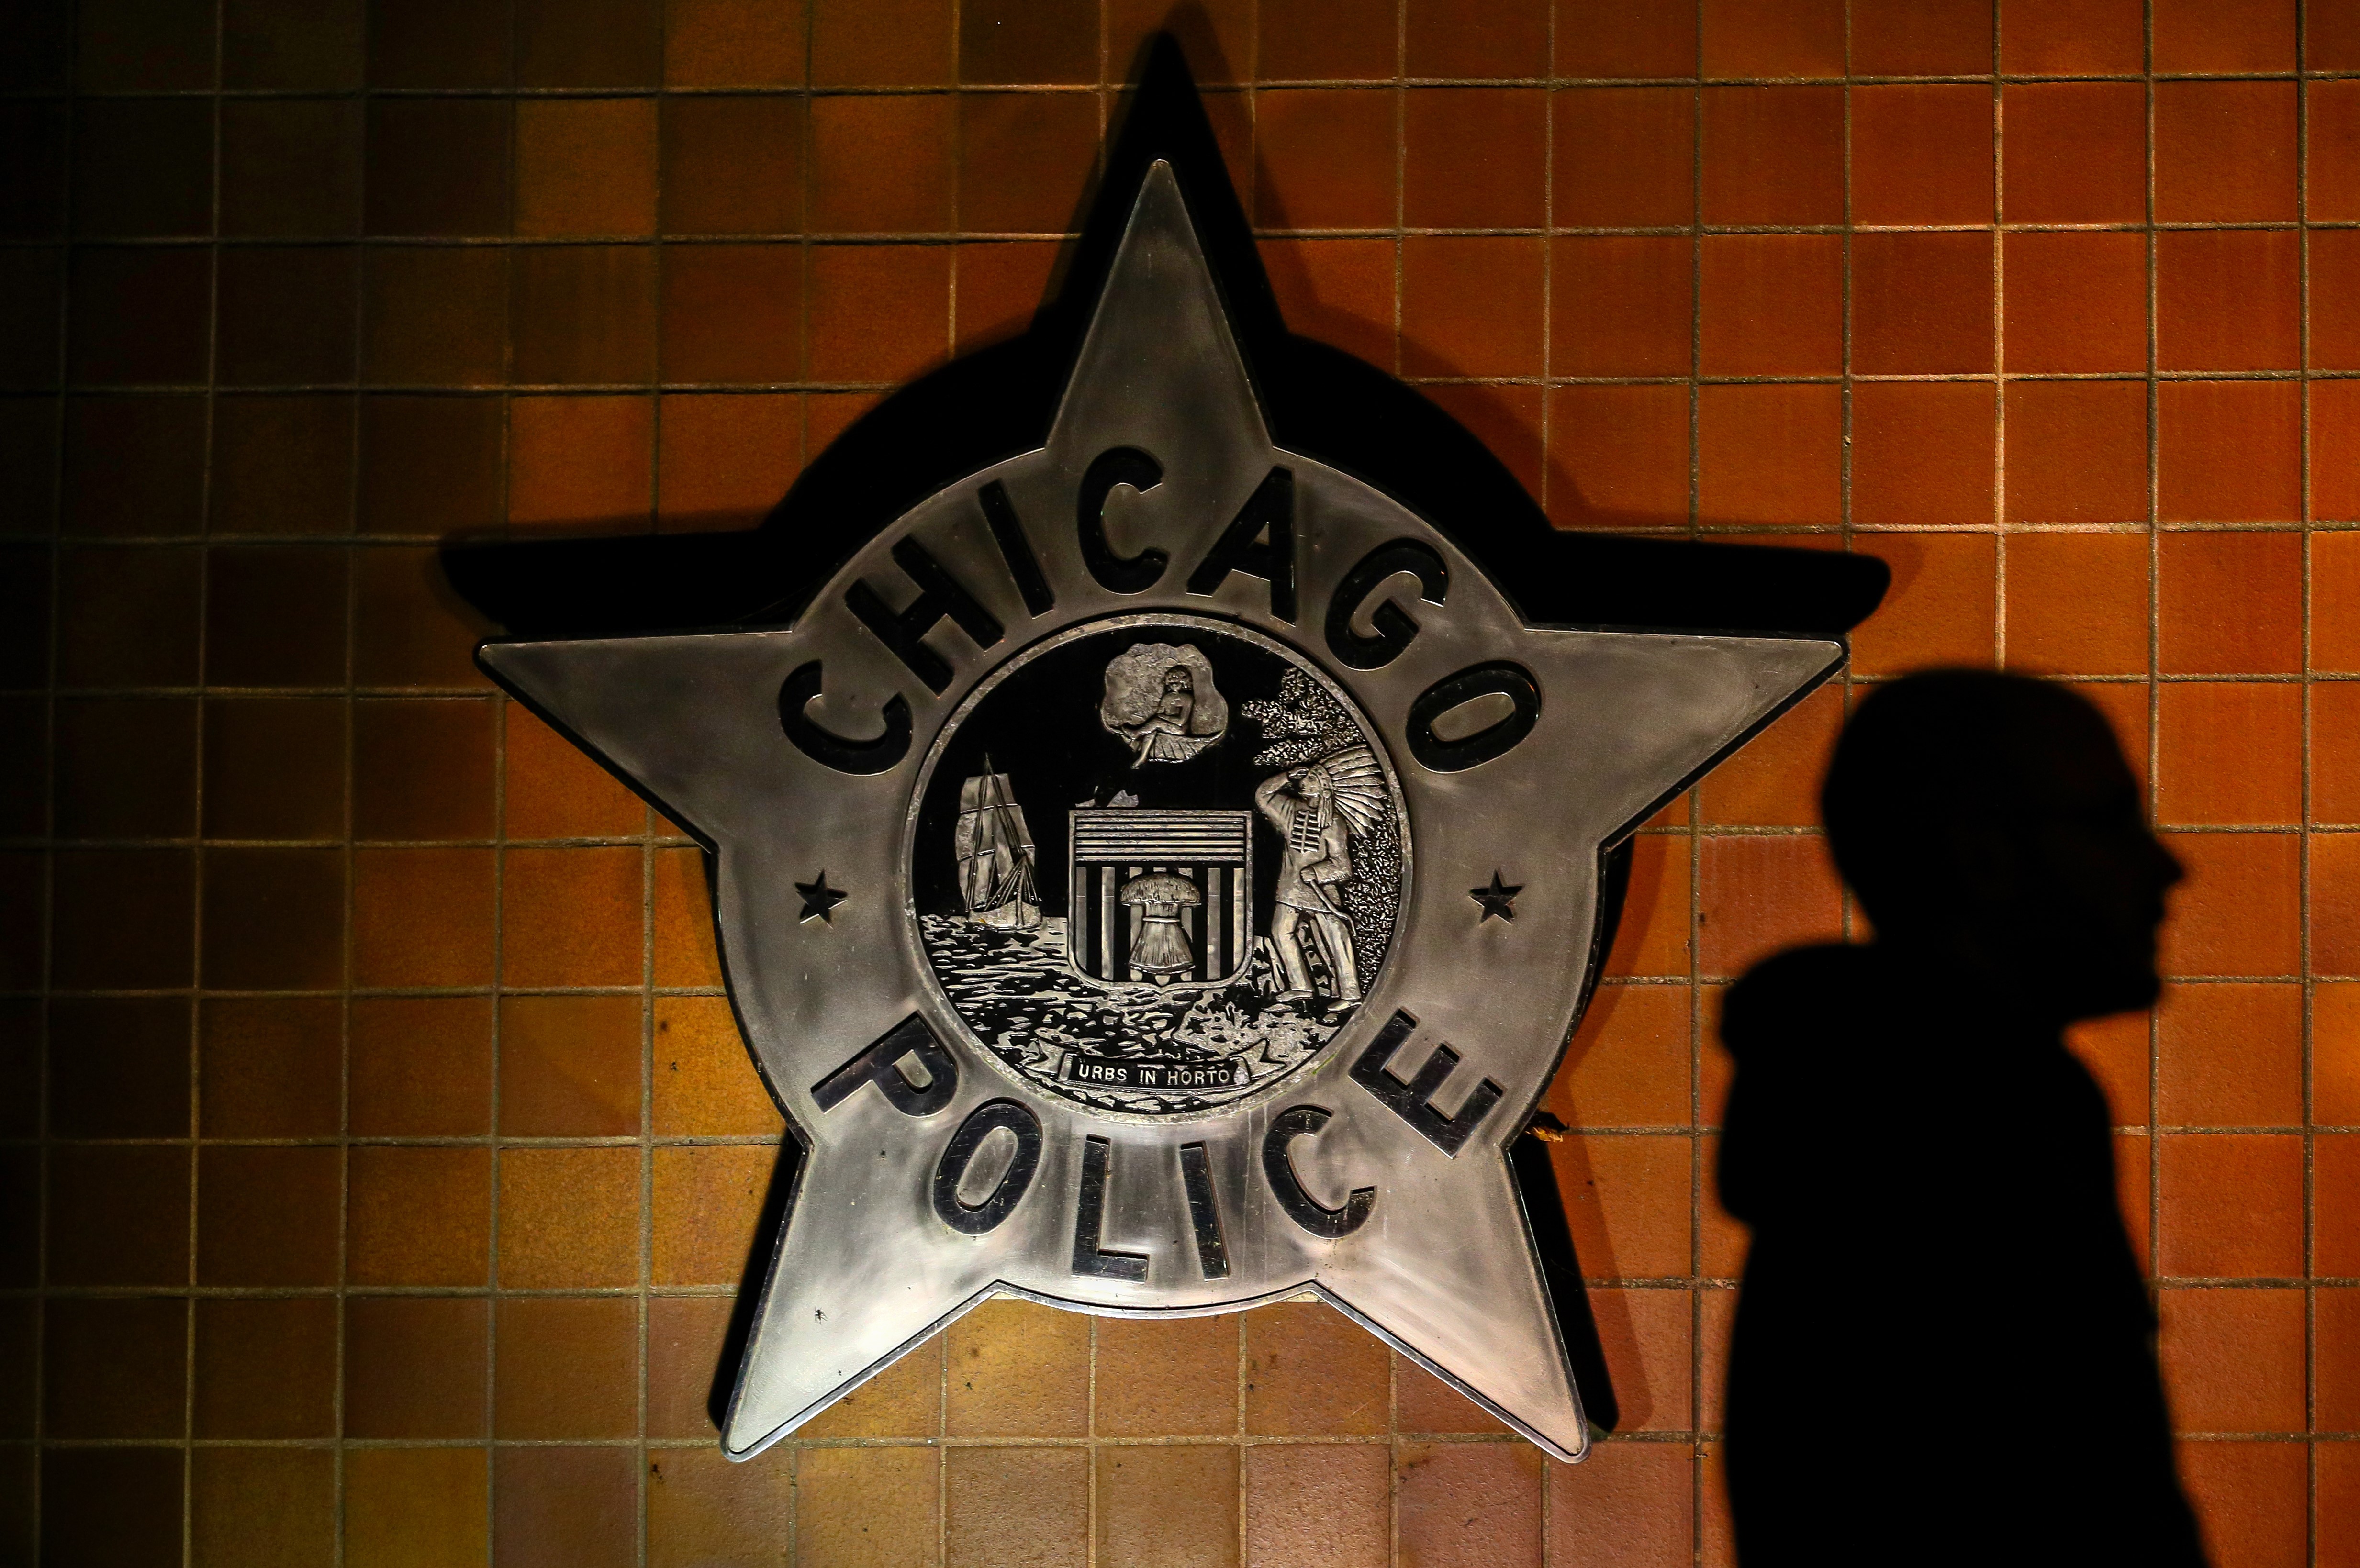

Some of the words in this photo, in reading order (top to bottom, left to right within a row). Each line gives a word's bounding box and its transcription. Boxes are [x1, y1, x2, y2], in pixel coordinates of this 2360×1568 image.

[779, 446, 1542, 775] CHICAGO
[811, 1010, 1503, 1283] POLICE
[1079, 1063, 1127, 1081] URBS
[1140, 1069, 1156, 1085] IN
[1167, 1069, 1230, 1086] HORTO
